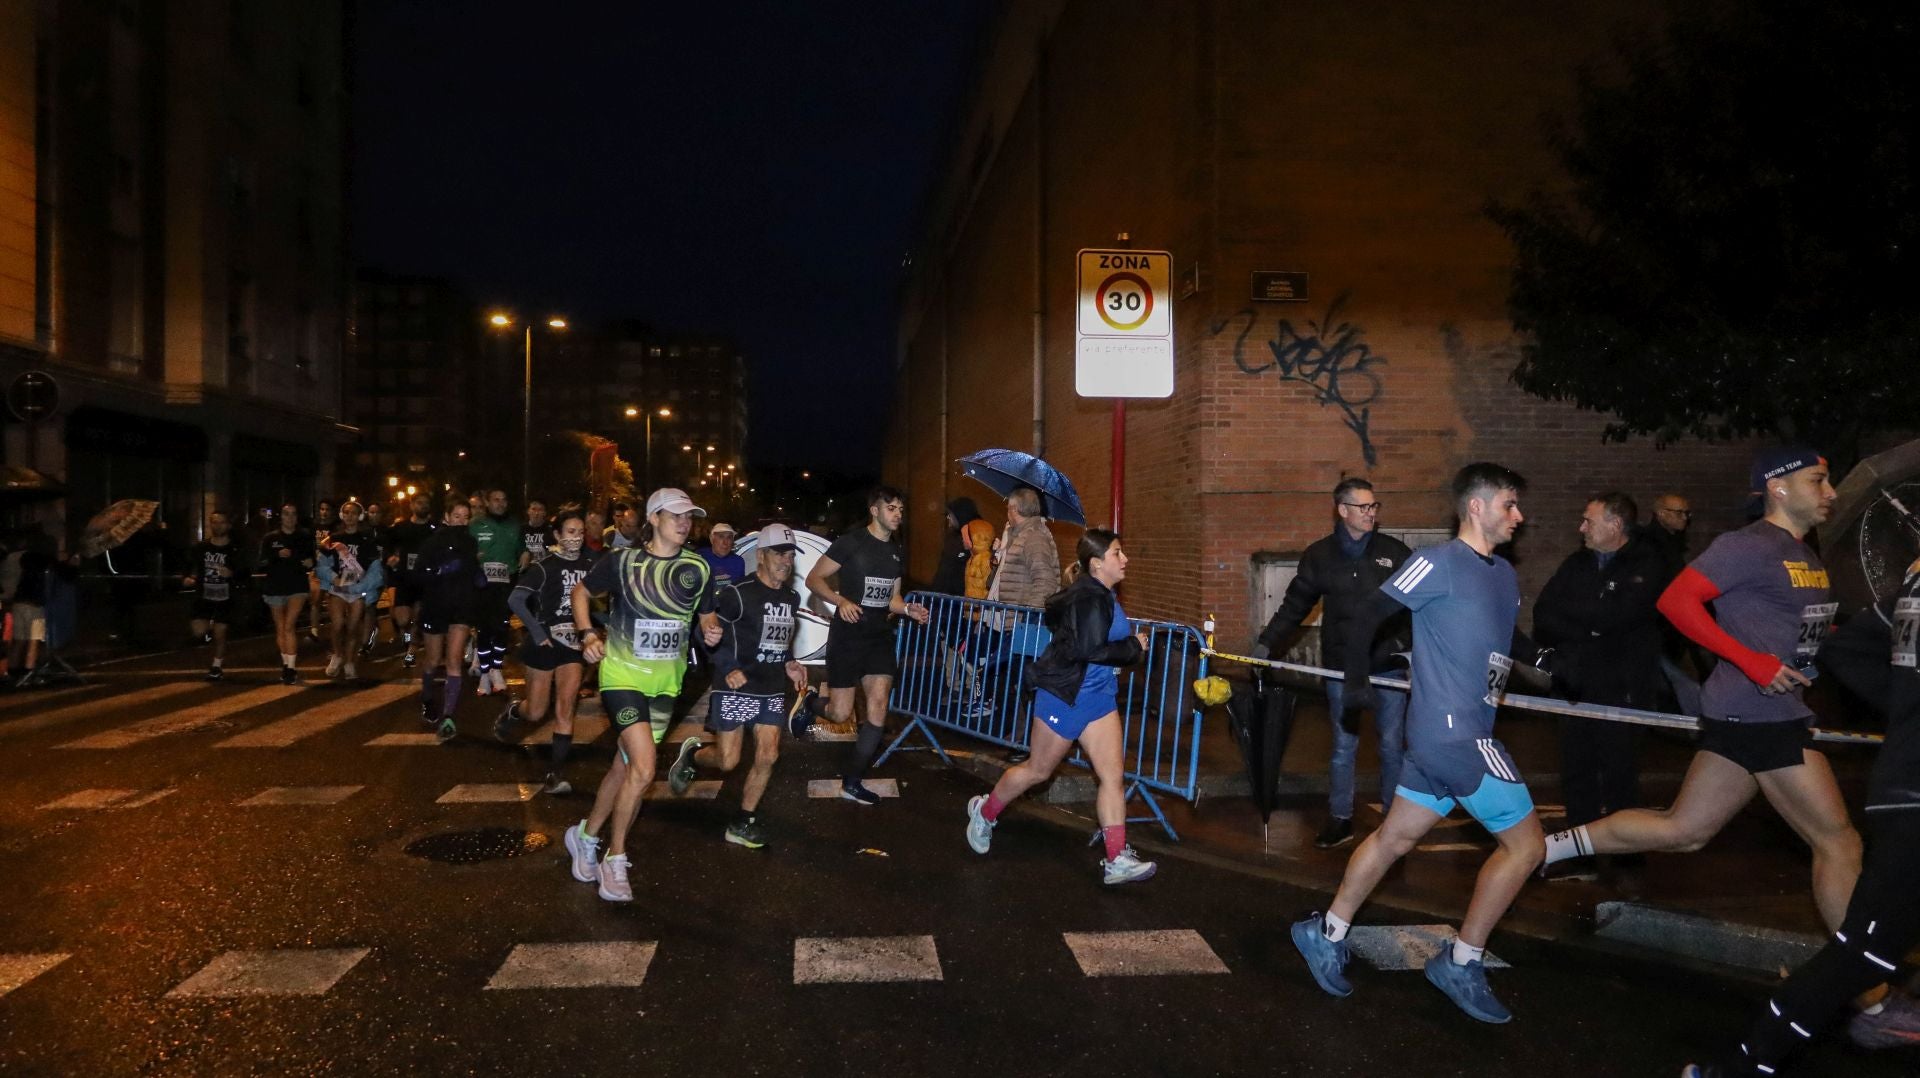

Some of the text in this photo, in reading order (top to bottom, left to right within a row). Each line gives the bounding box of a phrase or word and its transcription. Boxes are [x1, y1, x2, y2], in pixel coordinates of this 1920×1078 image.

[1099, 255, 1151, 270] ZONA
[1108, 292, 1141, 311] 30
[1764, 460, 1802, 480] RACING TEAM
[348, 544, 359, 555] 7K
[640, 631, 680, 649] 2099
[1798, 622, 1825, 644] 242
